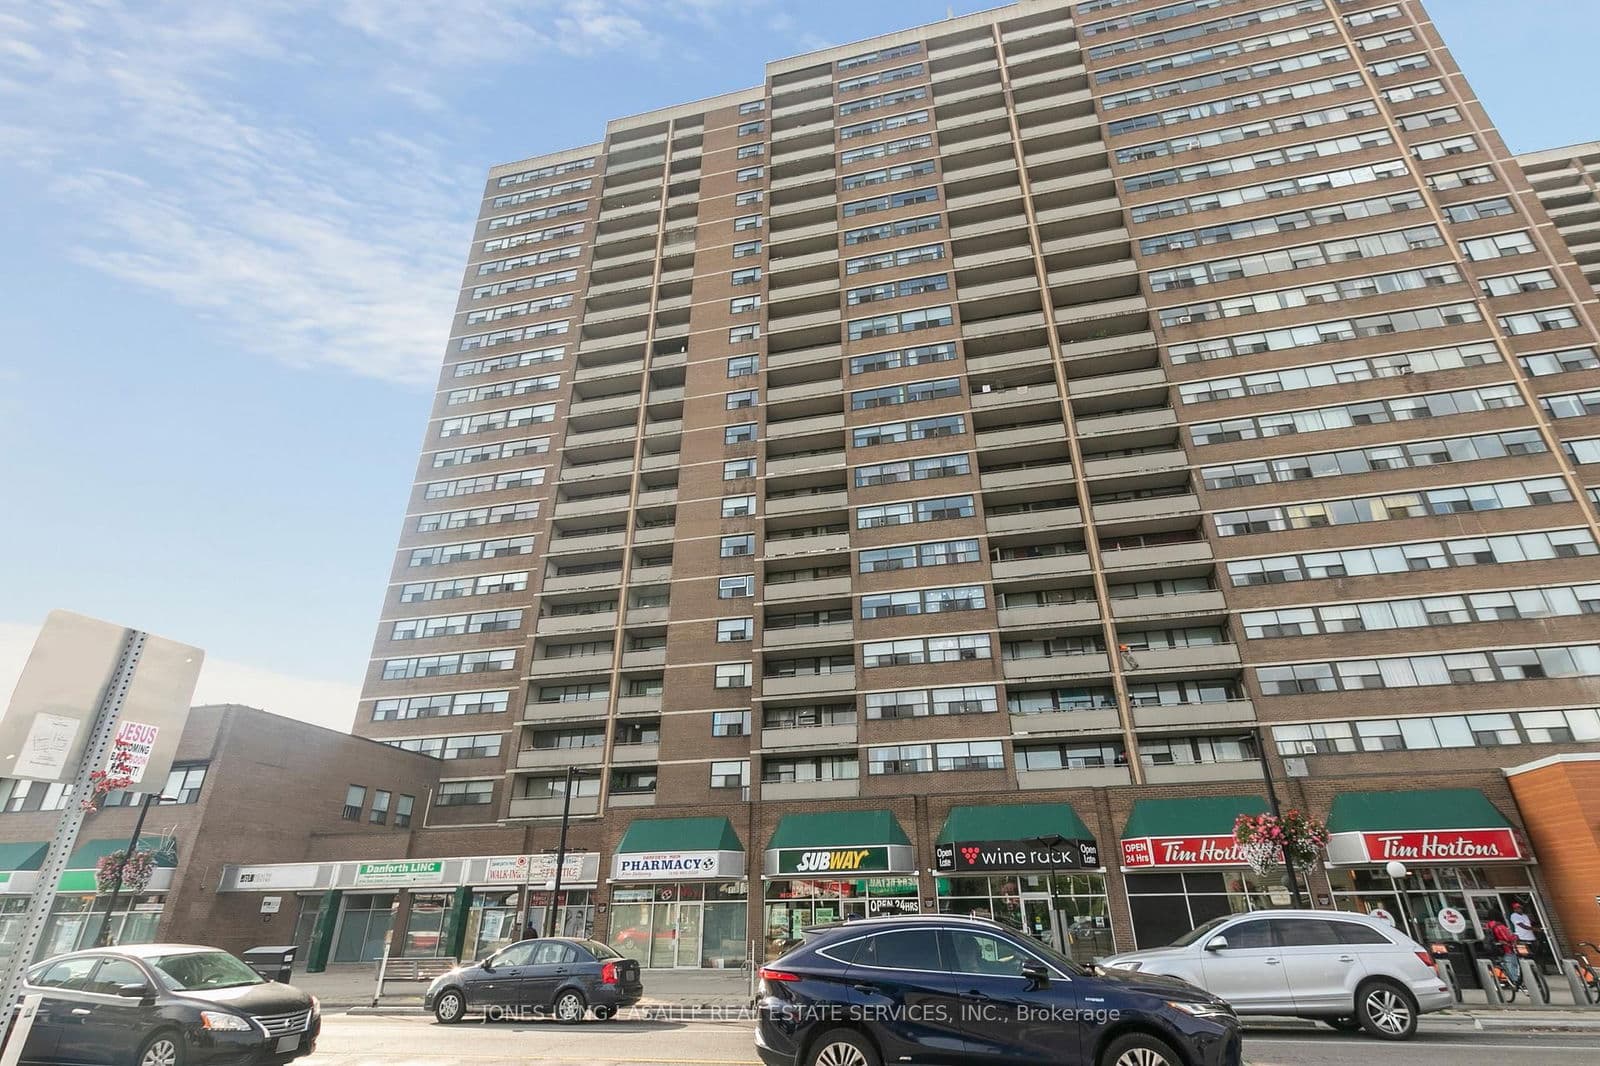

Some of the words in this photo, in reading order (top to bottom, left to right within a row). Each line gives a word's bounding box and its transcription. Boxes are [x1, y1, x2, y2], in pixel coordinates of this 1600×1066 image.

[119, 723, 157, 744] JESUS
[1080, 843, 1097, 854] Open
[1125, 842, 1147, 852] OPEN
[1161, 840, 1197, 863] Tim
[1200, 839, 1252, 862] Horto
[1377, 835, 1418, 858] Tim
[1421, 834, 1499, 857] Hortons
[936, 848, 953, 858] Open
[981, 848, 1026, 864] wine
[1125, 855, 1135, 863] 24
[1137, 854, 1149, 863] Hrs
[622, 859, 702, 871] PHARMACY
[796, 849, 870, 872] SUBWAY
[939, 858, 951, 866] Late
[366, 863, 408, 873] Danforth
[411, 862, 435, 872] LINC
